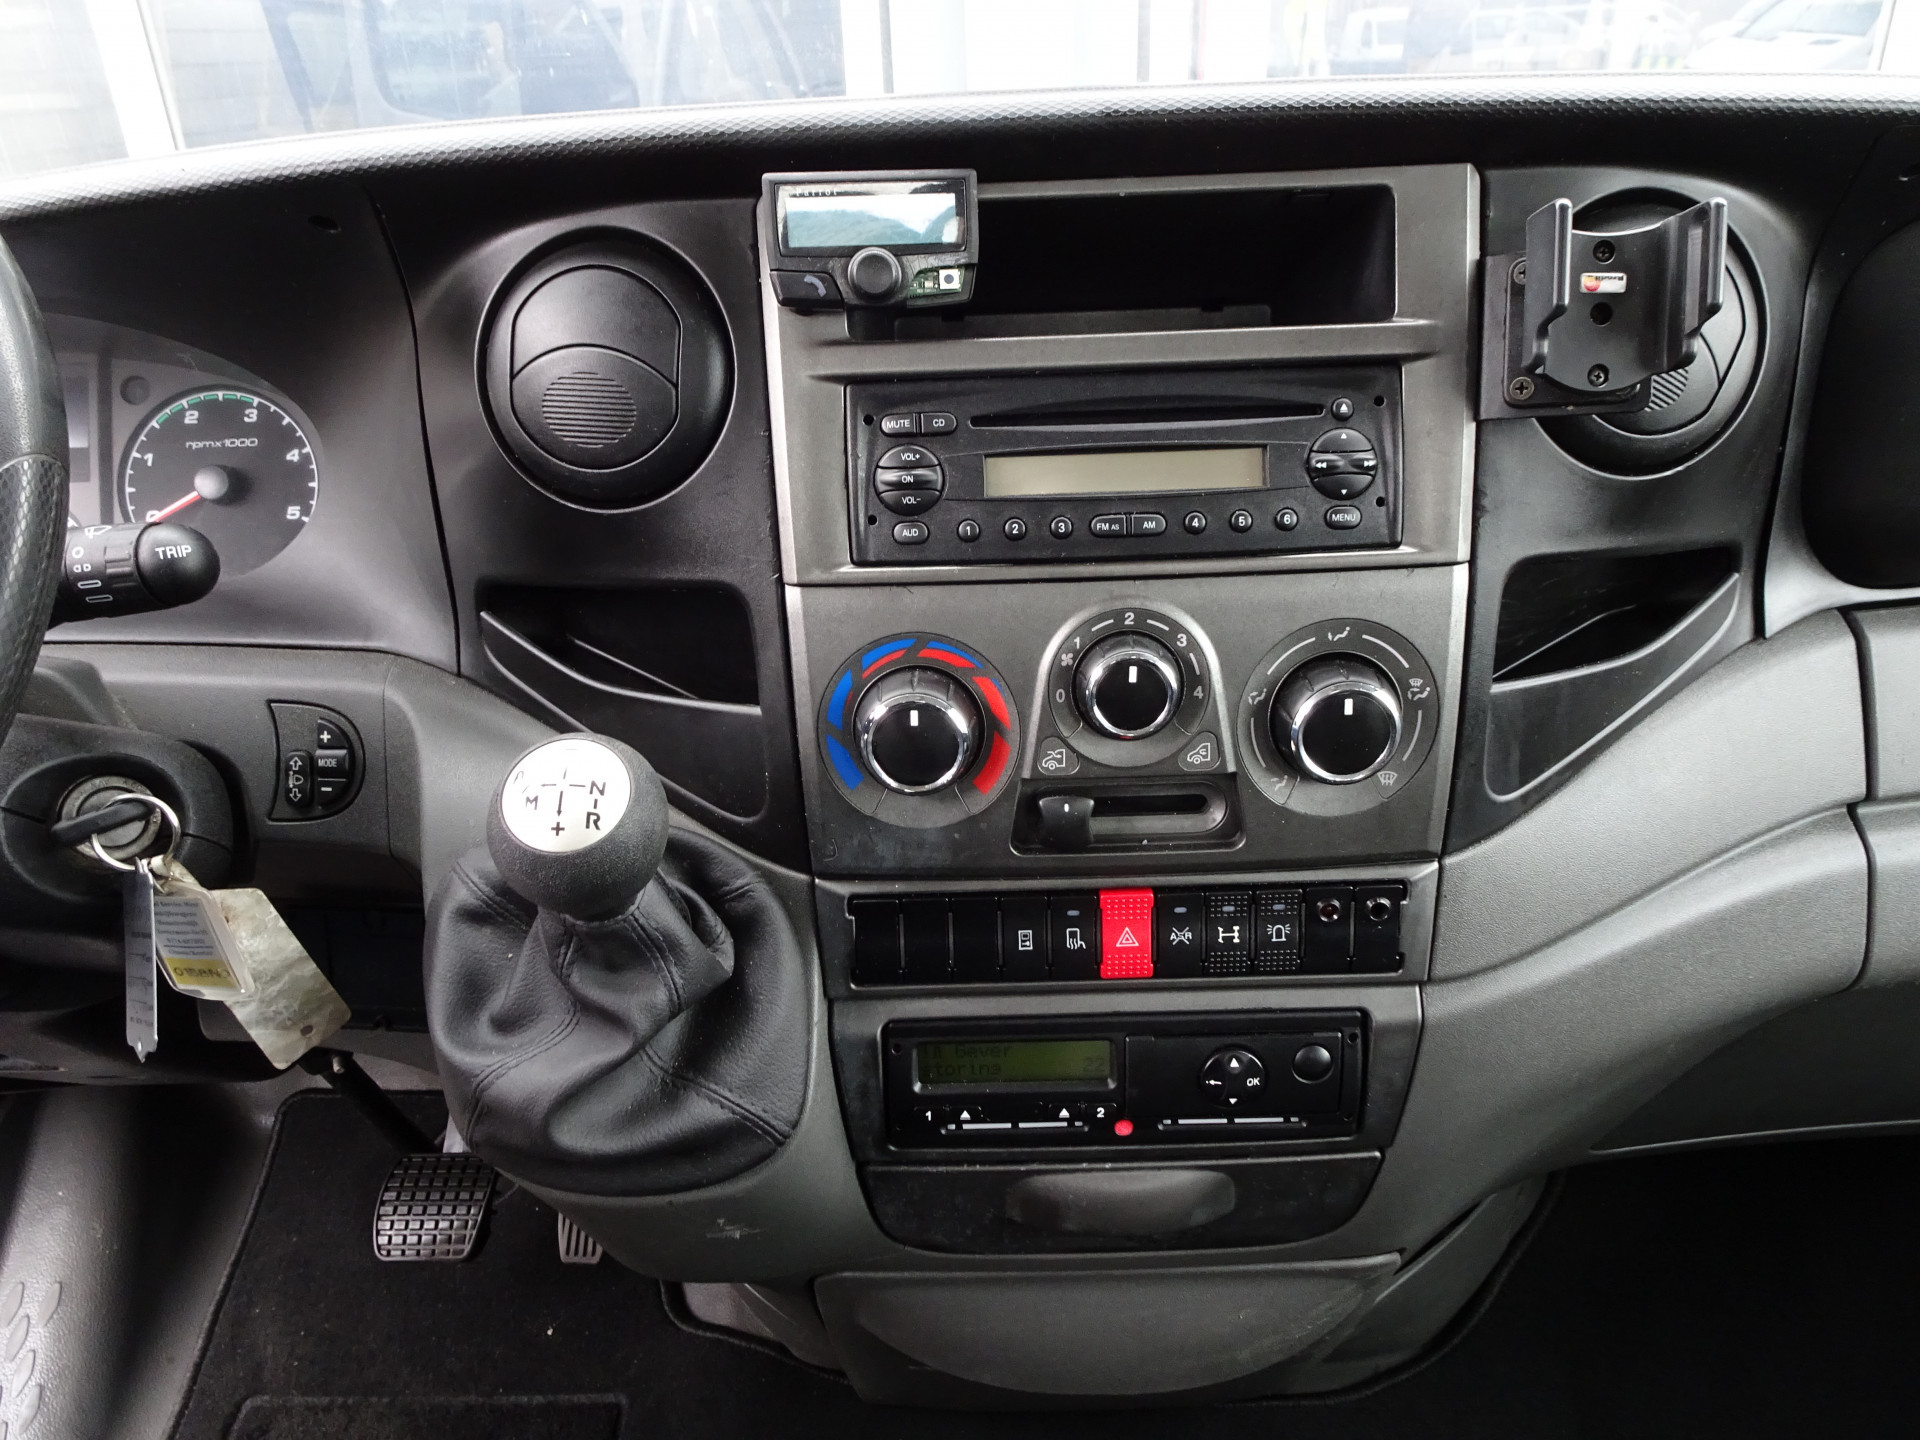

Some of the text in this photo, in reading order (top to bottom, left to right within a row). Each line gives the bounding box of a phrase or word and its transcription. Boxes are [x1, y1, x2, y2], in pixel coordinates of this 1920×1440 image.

[184, 411, 199, 424] 2
[244, 409, 258, 422] 3
[886, 419, 911, 429] MUTE
[932, 418, 946, 428] CD
[185, 438, 258, 450] rpmx1000
[144, 453, 154, 467] 1
[286, 449, 300, 462] 4
[901, 453, 920, 461] VOL+
[901, 475, 914, 484] ON
[286, 506, 301, 520] 5
[1332, 512, 1356, 523] MENU
[1142, 520, 1156, 530] AM
[1192, 518, 1199, 528] 4
[1239, 516, 1246, 526] 5
[1284, 514, 1291, 525] 6
[902, 528, 919, 538] AUD
[966, 526, 971, 536] 1
[1012, 524, 1019, 534] 2
[1058, 523, 1066, 533] 3
[1096, 523, 1110, 532] FM
[155, 545, 192, 560] TRIP
[1124, 612, 1135, 625] 2
[1073, 636, 1081, 649] 1
[1176, 634, 1188, 647] 3
[1055, 689, 1066, 703] 0
[1193, 686, 1204, 699] 4
[318, 758, 338, 768] MODE
[589, 780, 606, 796] N
[525, 795, 539, 811] M
[585, 811, 601, 831] R
[1246, 1077, 1260, 1087] OK
[925, 1110, 932, 1121] 1
[1096, 1107, 1105, 1118] 2
